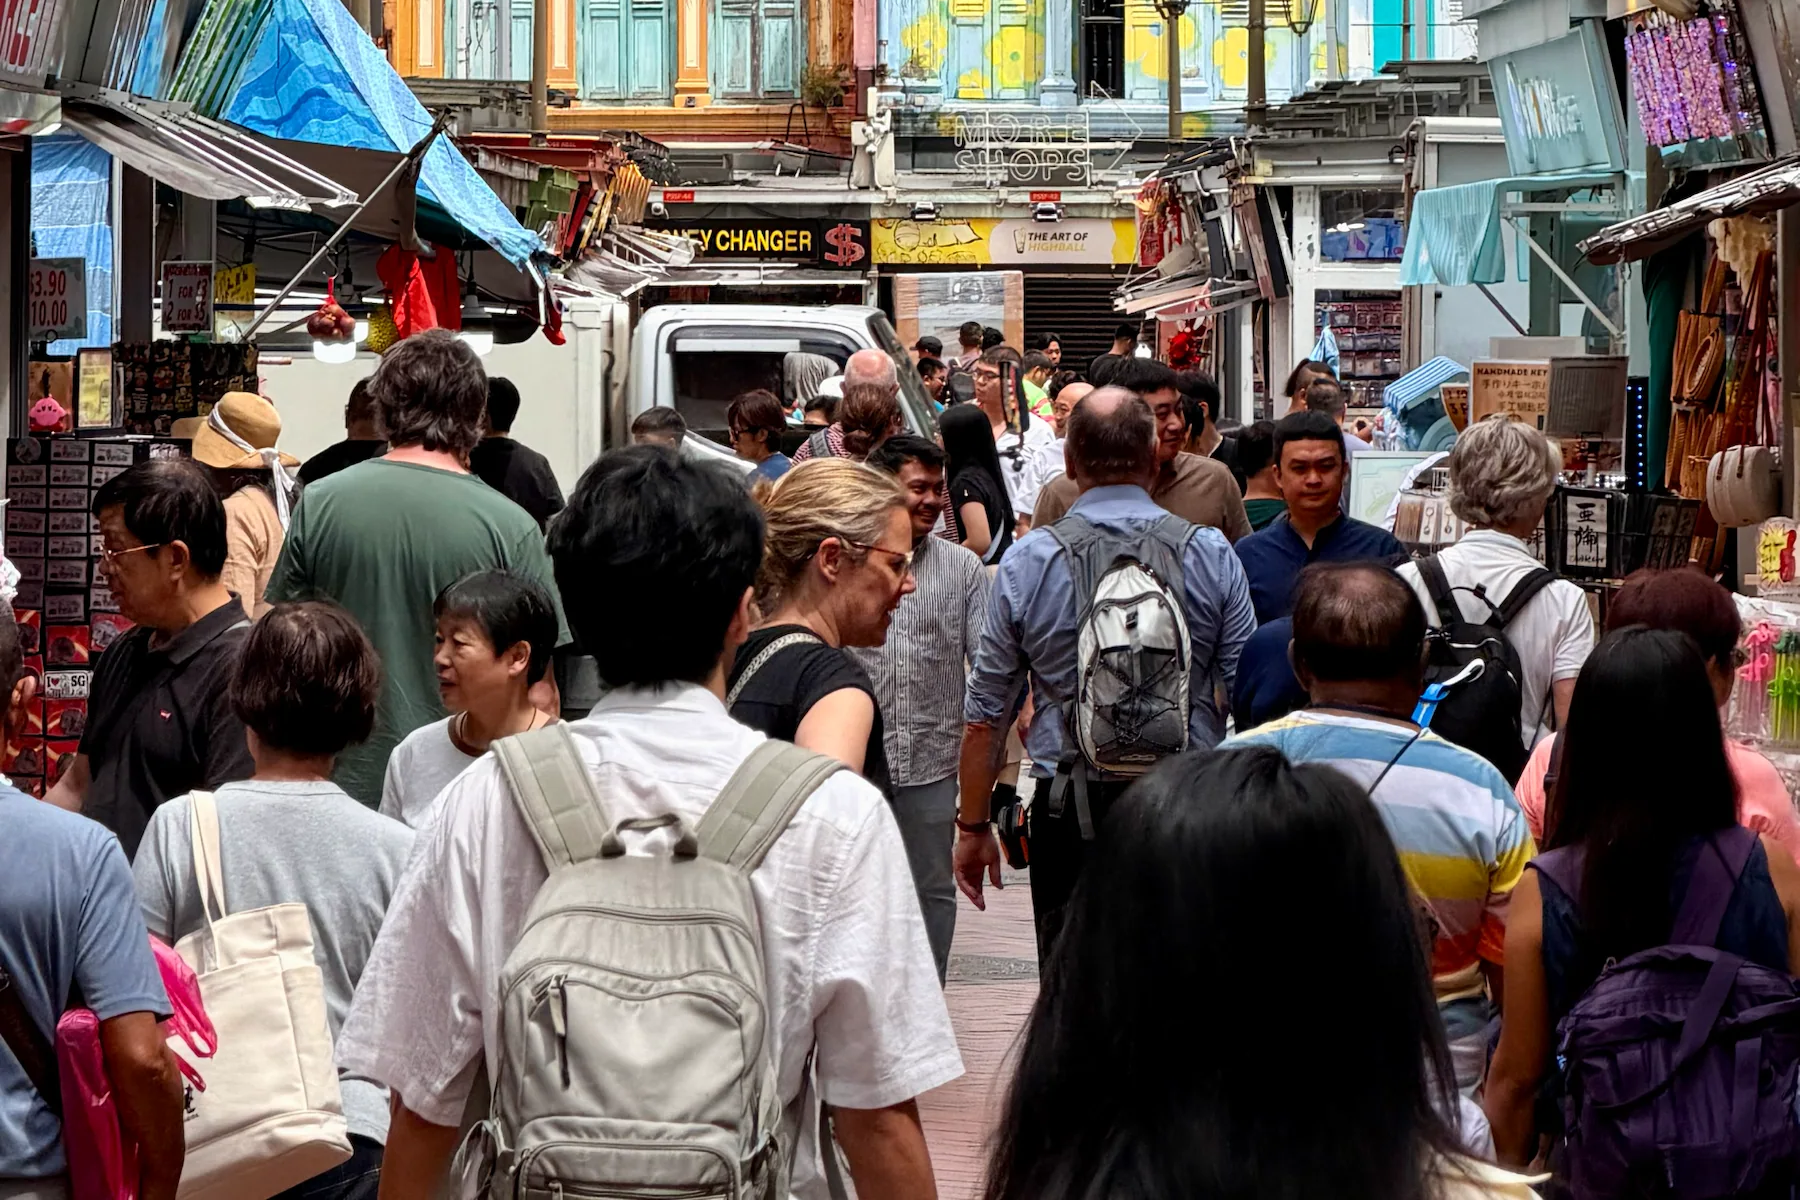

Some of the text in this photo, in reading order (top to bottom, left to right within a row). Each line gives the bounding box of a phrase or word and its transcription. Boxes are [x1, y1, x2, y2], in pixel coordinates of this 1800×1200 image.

[955, 114, 1086, 147] MORE
[955, 149, 1087, 181] SHOPS
[716, 229, 812, 252] CHANGER
[1028, 233, 1088, 241] THE ART OF
[1028, 242, 1086, 252] HIGHBALL
[178, 286, 193, 298] FOR
[167, 301, 174, 321] 2
[177, 309, 191, 320] FOR
[1477, 368, 1528, 376] HANDMADE
[71, 675, 86, 687] SG
